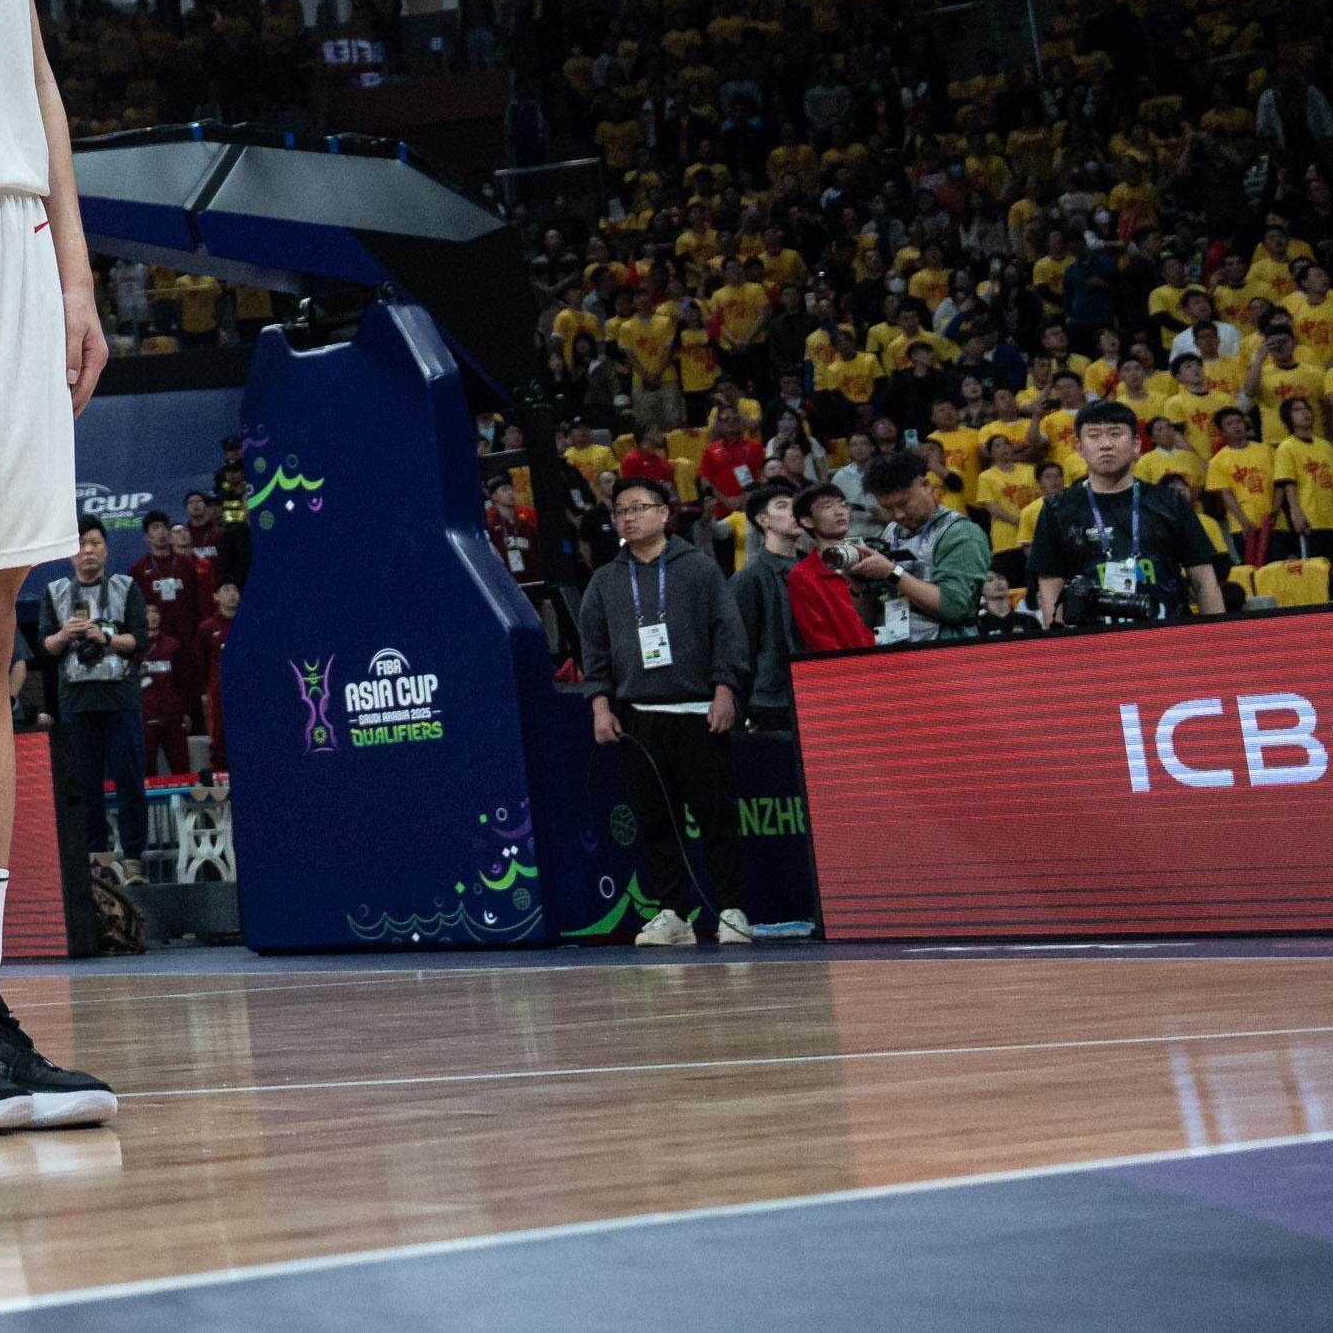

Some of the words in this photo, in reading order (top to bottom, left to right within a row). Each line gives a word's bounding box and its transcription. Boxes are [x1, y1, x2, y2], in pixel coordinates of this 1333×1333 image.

[84, 493, 153, 513] CUP
[376, 659, 402, 676] FIBA
[345, 679, 394, 712] ASIA
[396, 674, 438, 706] CUP
[358, 712, 381, 725] SAUDI
[411, 707, 431, 719] 2025
[350, 721, 443, 747] QUALIFIERS
[1119, 692, 1329, 792] ICB
